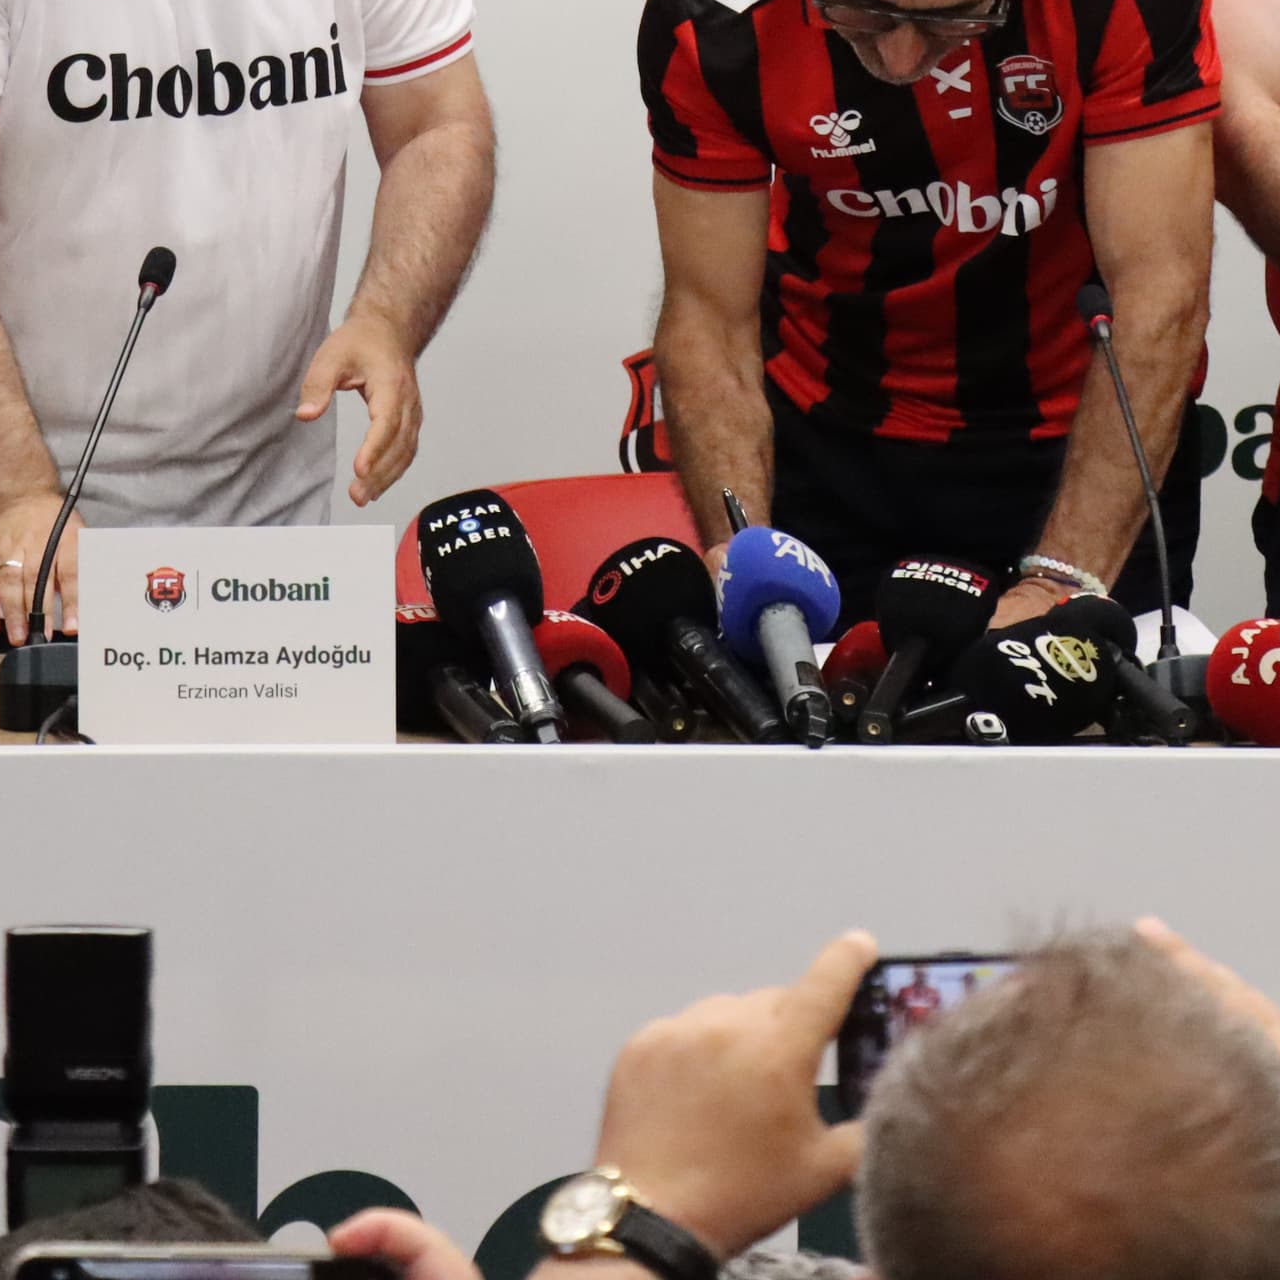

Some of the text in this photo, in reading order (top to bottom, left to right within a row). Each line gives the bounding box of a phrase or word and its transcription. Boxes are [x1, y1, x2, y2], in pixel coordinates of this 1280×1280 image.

[46, 22, 348, 123] Chobani
[810, 138, 877, 159] hummel
[429, 503, 501, 533] NAZAR
[437, 526, 511, 557] HABER
[211, 576, 330, 603] Chobani
[891, 569, 982, 597] Erzincan
[103, 644, 371, 671] Doç. Dr. Hamza Aydoğdu
[177, 683, 298, 700] Erzincan Valisi
